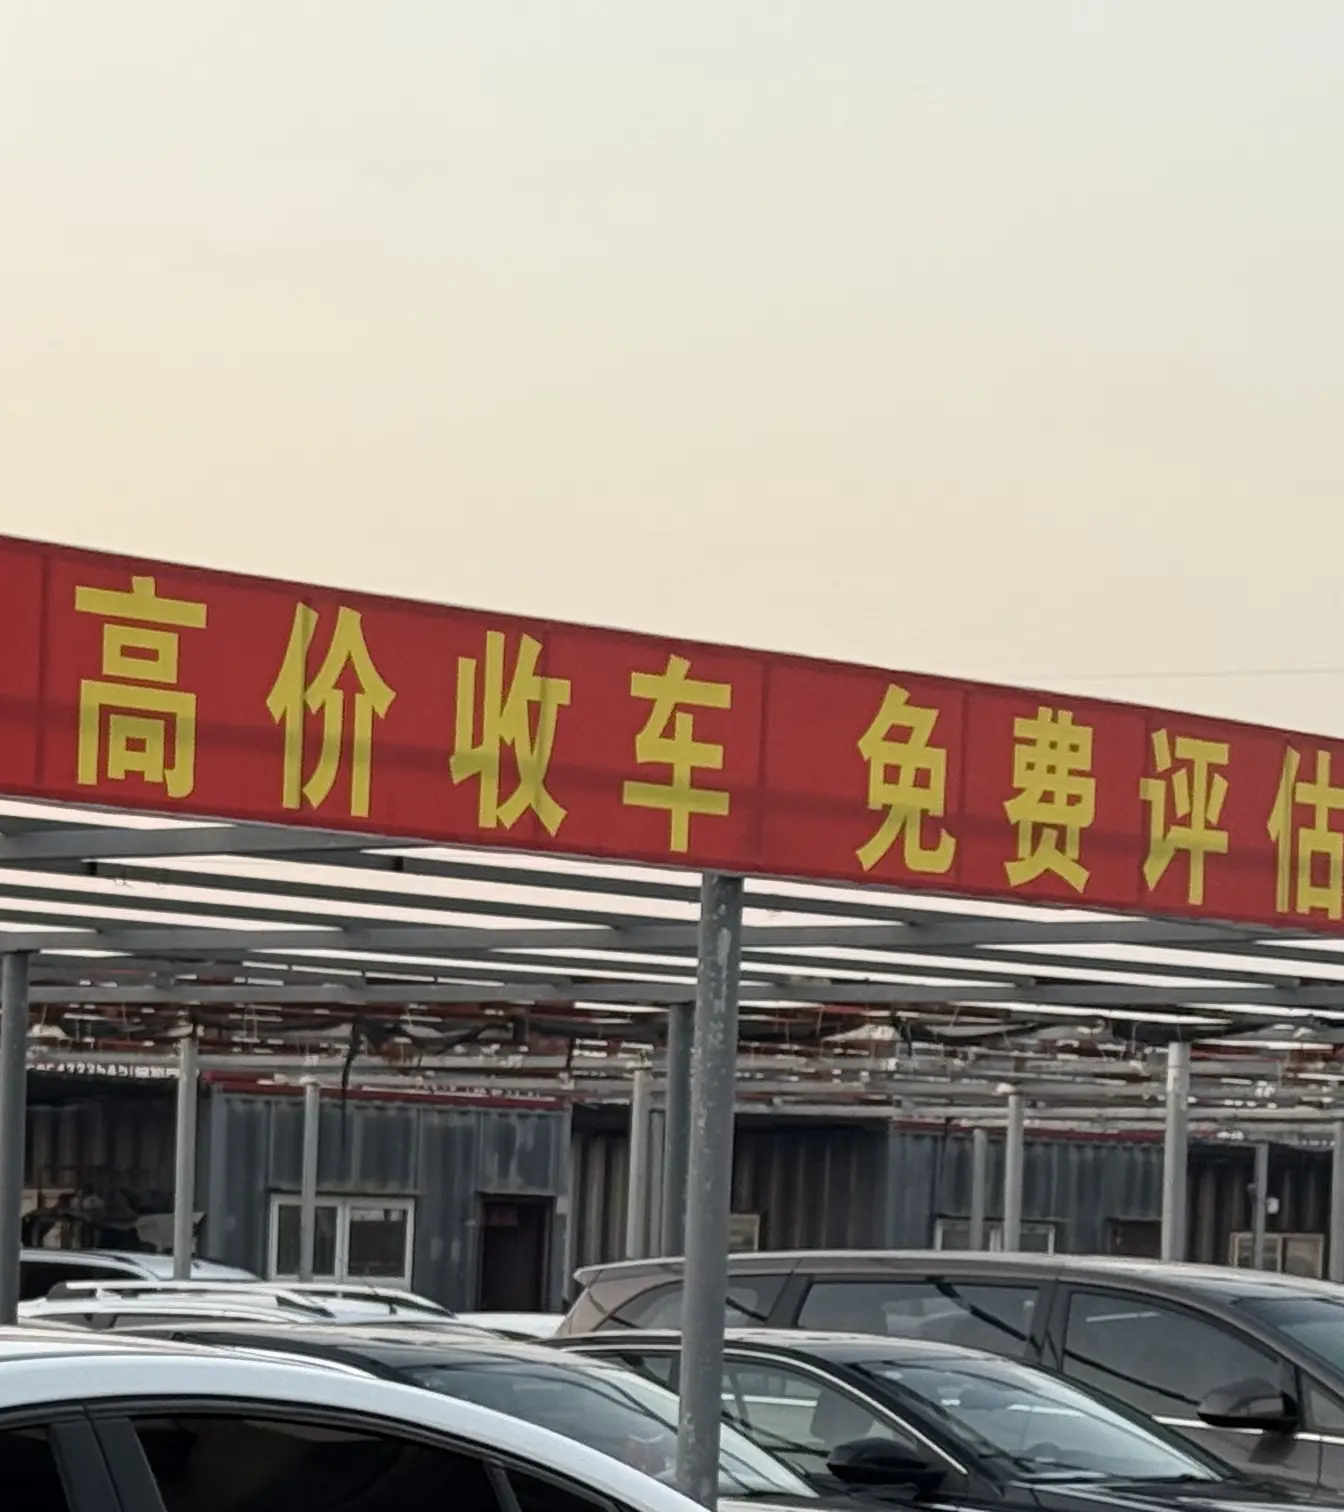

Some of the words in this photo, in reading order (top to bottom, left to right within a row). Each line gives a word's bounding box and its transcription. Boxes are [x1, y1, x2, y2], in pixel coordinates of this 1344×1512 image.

[73, 576, 732, 853] 高价收车
[856, 685, 1344, 916] 免费评估
